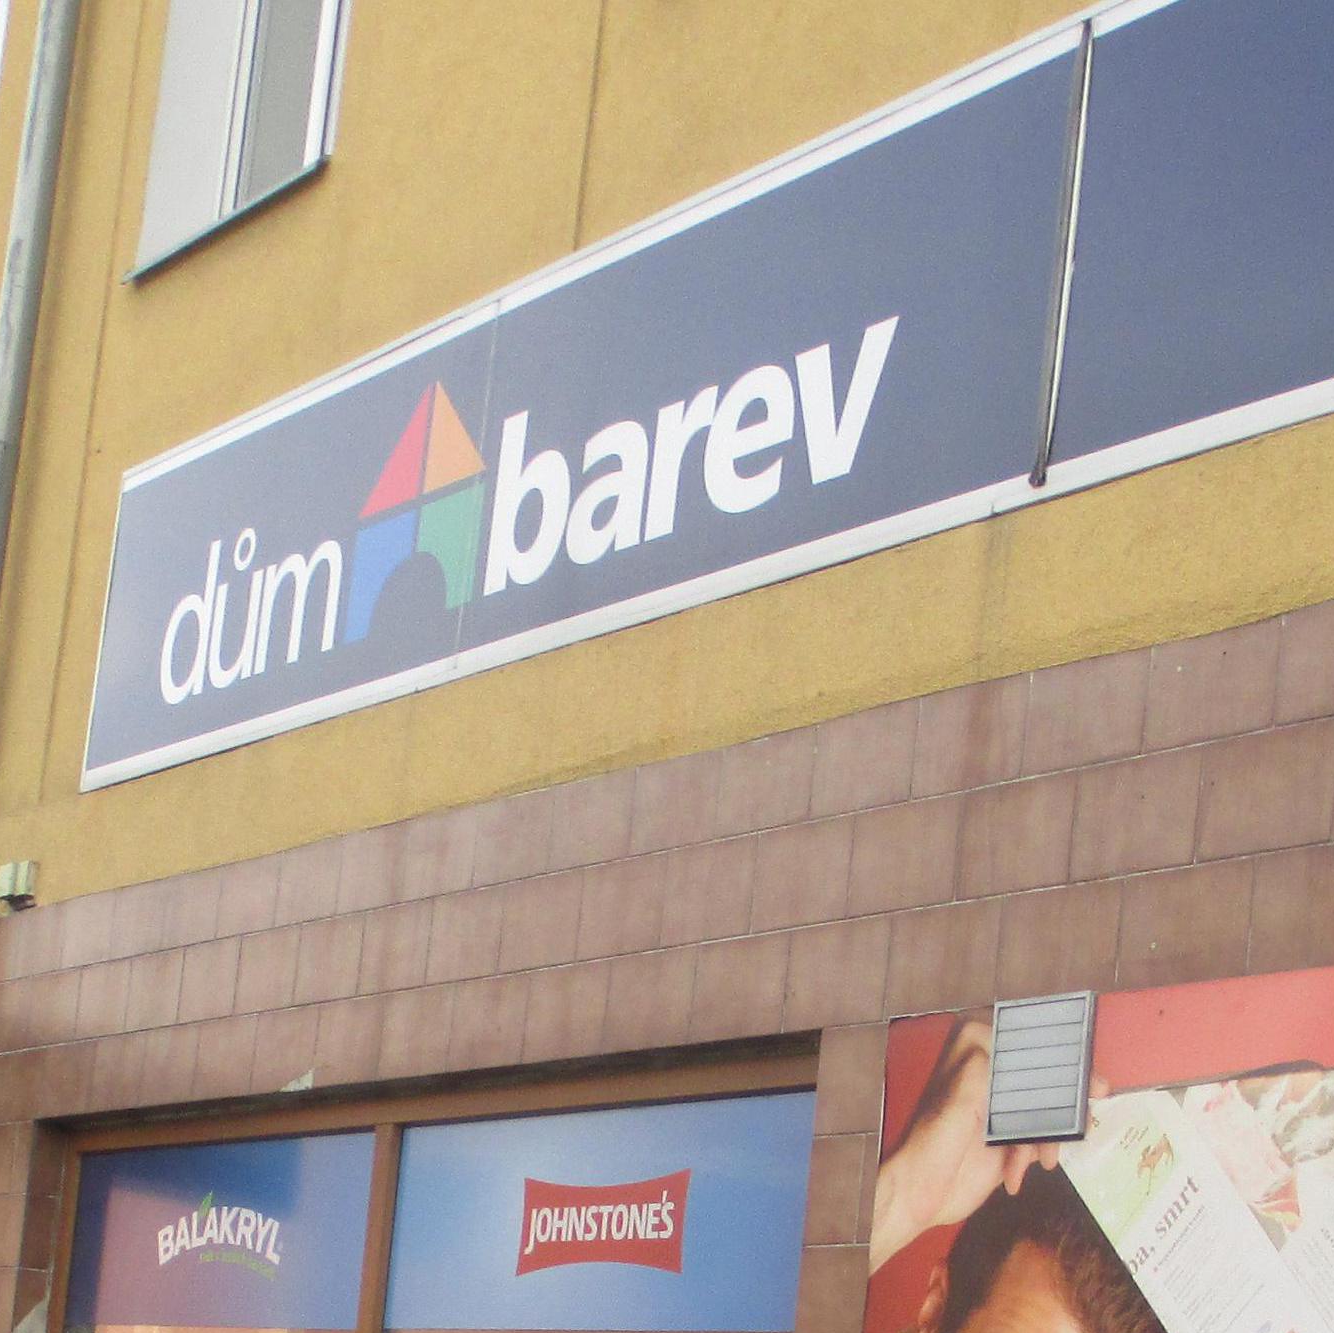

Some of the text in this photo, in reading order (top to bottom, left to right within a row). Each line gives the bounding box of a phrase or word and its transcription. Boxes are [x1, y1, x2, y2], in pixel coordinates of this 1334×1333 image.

[160, 315, 899, 706] dům barev
[157, 1205, 281, 1266] BALAKRYL
[522, 1188, 676, 1256] JOHNSTONE'S
[1154, 1174, 1201, 1241] smrt
